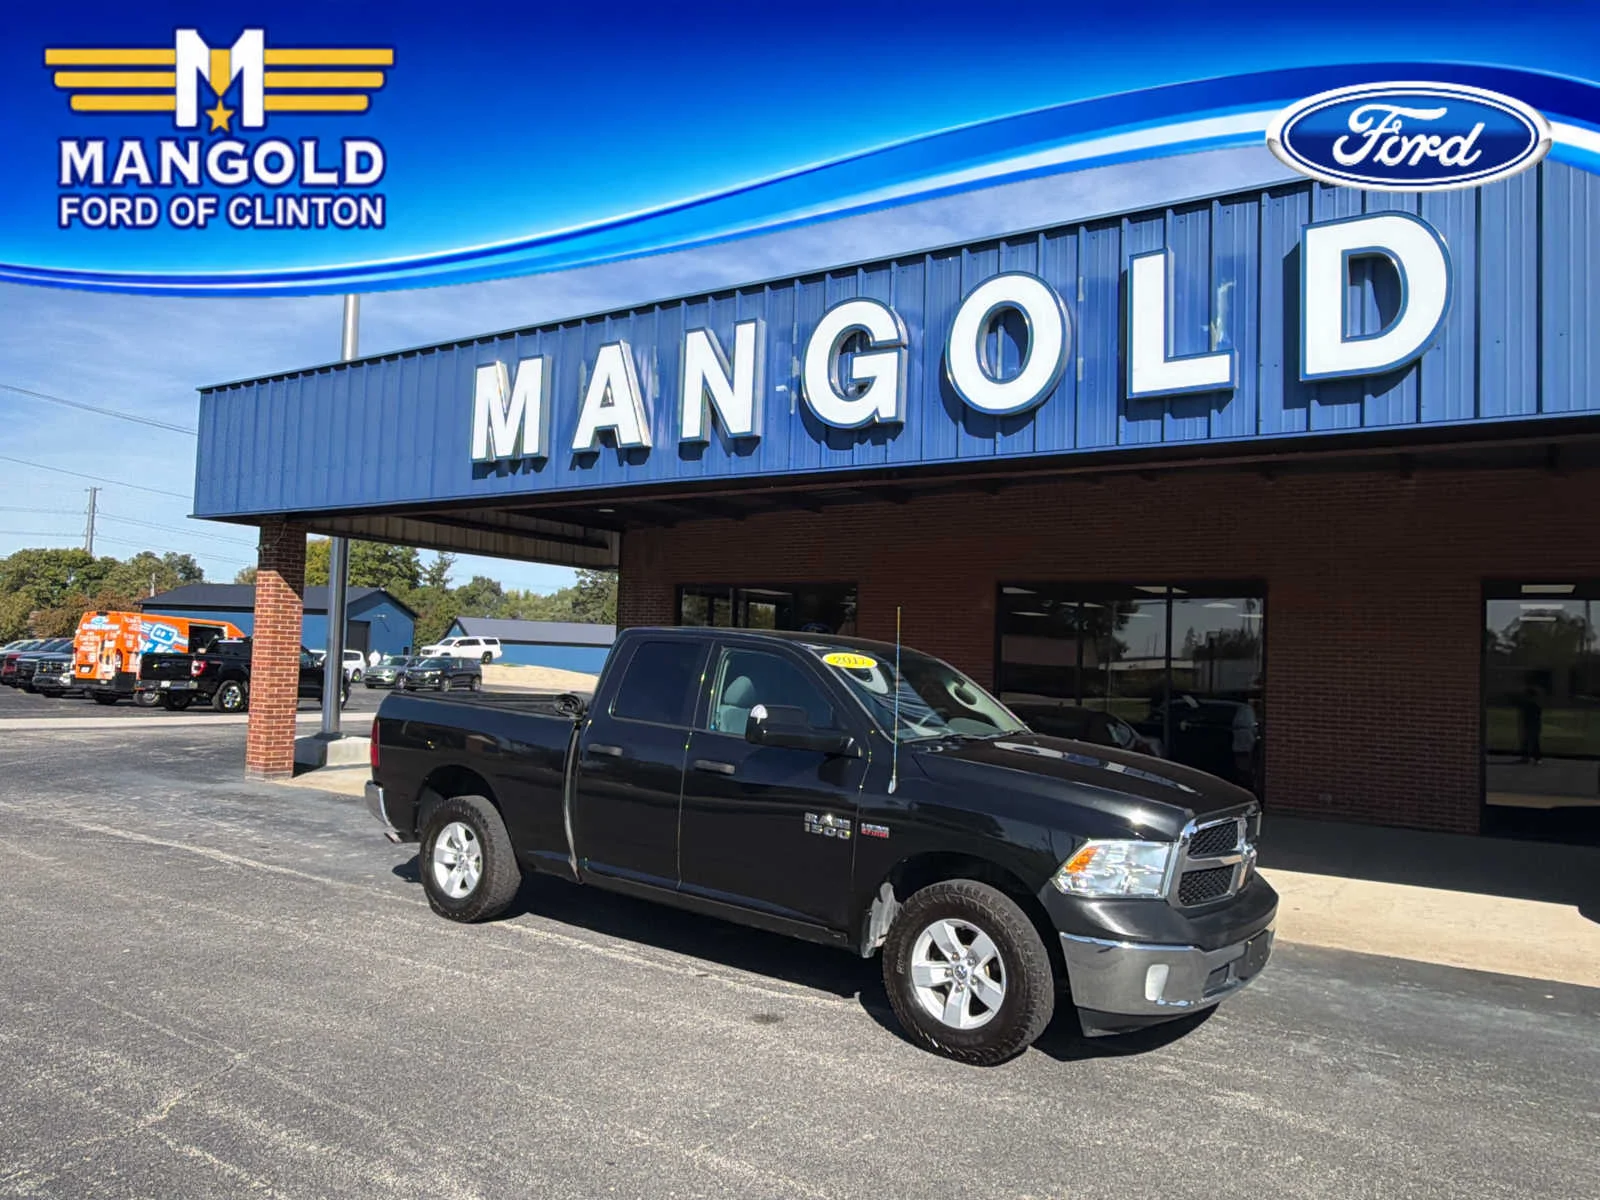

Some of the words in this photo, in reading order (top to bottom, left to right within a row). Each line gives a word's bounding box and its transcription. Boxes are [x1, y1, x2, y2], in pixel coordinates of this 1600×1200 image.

[471, 213, 1450, 462] MANGOLD
[833, 655, 867, 665] 2017
[804, 823, 851, 839] 1500
